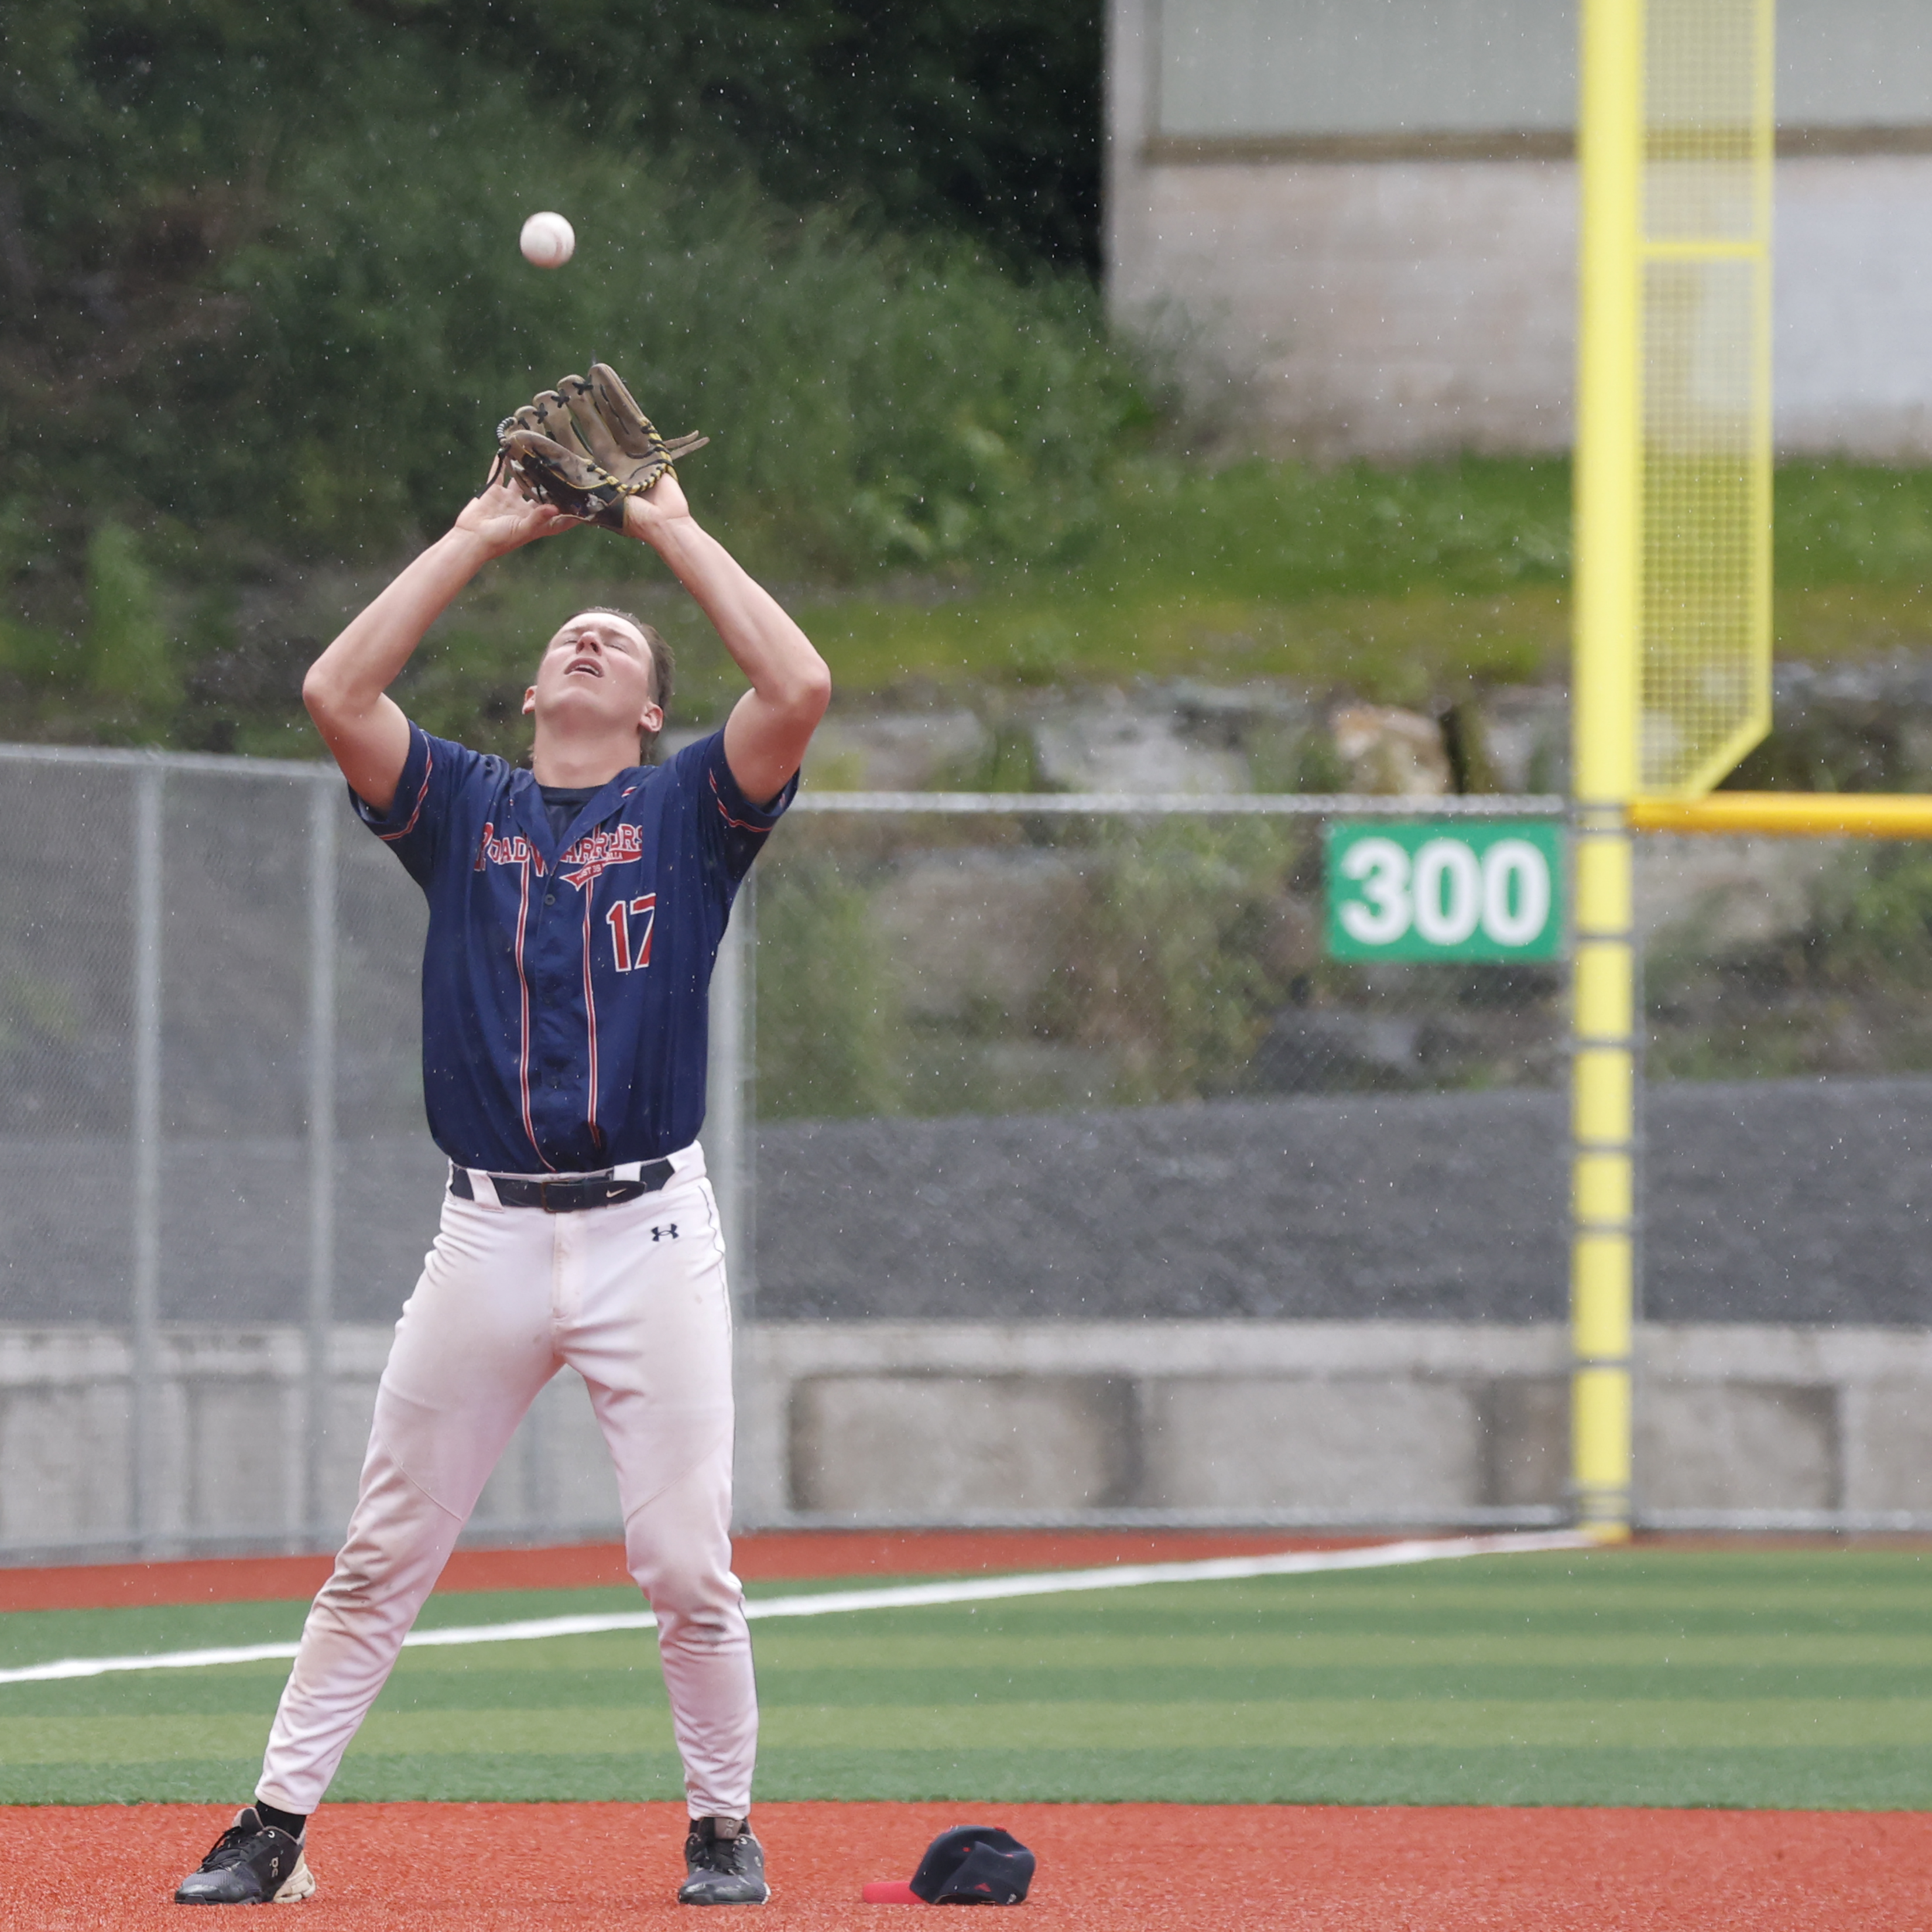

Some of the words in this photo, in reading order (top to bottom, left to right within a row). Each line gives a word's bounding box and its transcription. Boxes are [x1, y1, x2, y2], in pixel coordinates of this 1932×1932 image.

[523, 823, 642, 877] ARRORS
[1341, 836, 1551, 947] 300
[606, 893, 656, 972] 17
